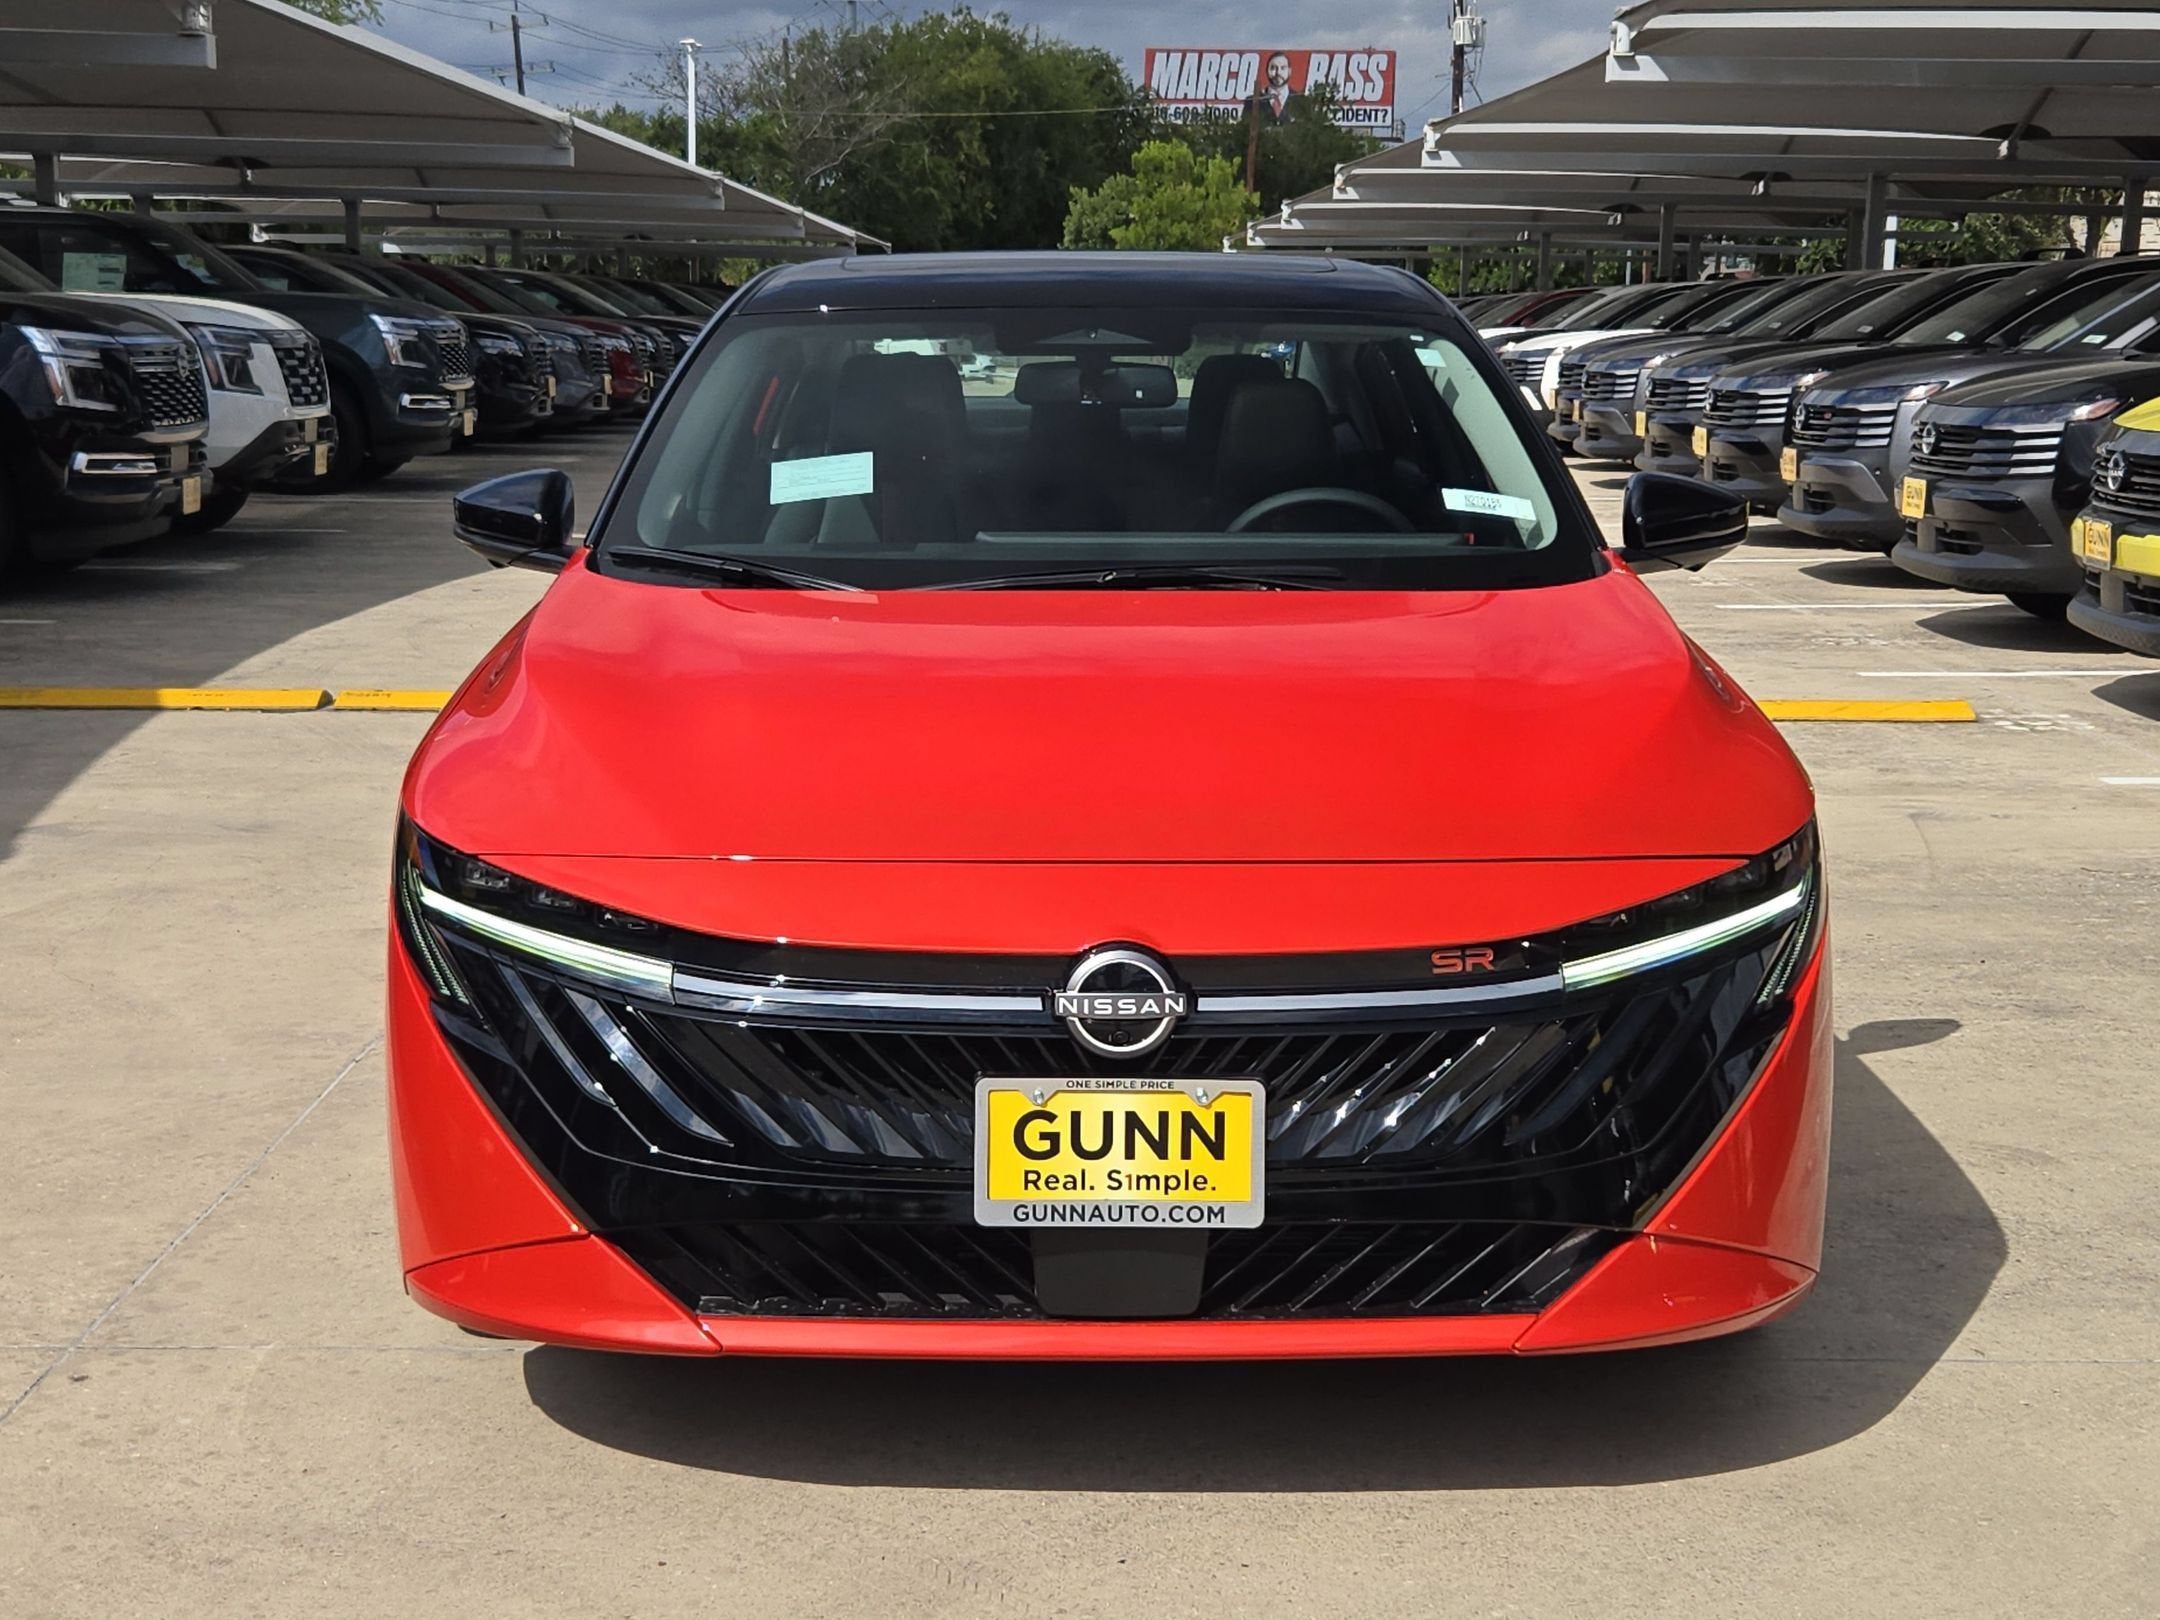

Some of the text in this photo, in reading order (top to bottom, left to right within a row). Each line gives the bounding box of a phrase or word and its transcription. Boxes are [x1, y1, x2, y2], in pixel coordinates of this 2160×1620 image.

[1151, 52, 1260, 100] MARCO
[1431, 947, 1495, 975] SR
[1058, 997, 1184, 1015] NISSAN
[1066, 1080, 1175, 1090] ONE SIMPLE PRICE
[1013, 1109, 1226, 1161] GUNN
[1023, 1169, 1095, 1191] Real.
[1013, 1204, 1225, 1223] GUNNAUTO.COM
